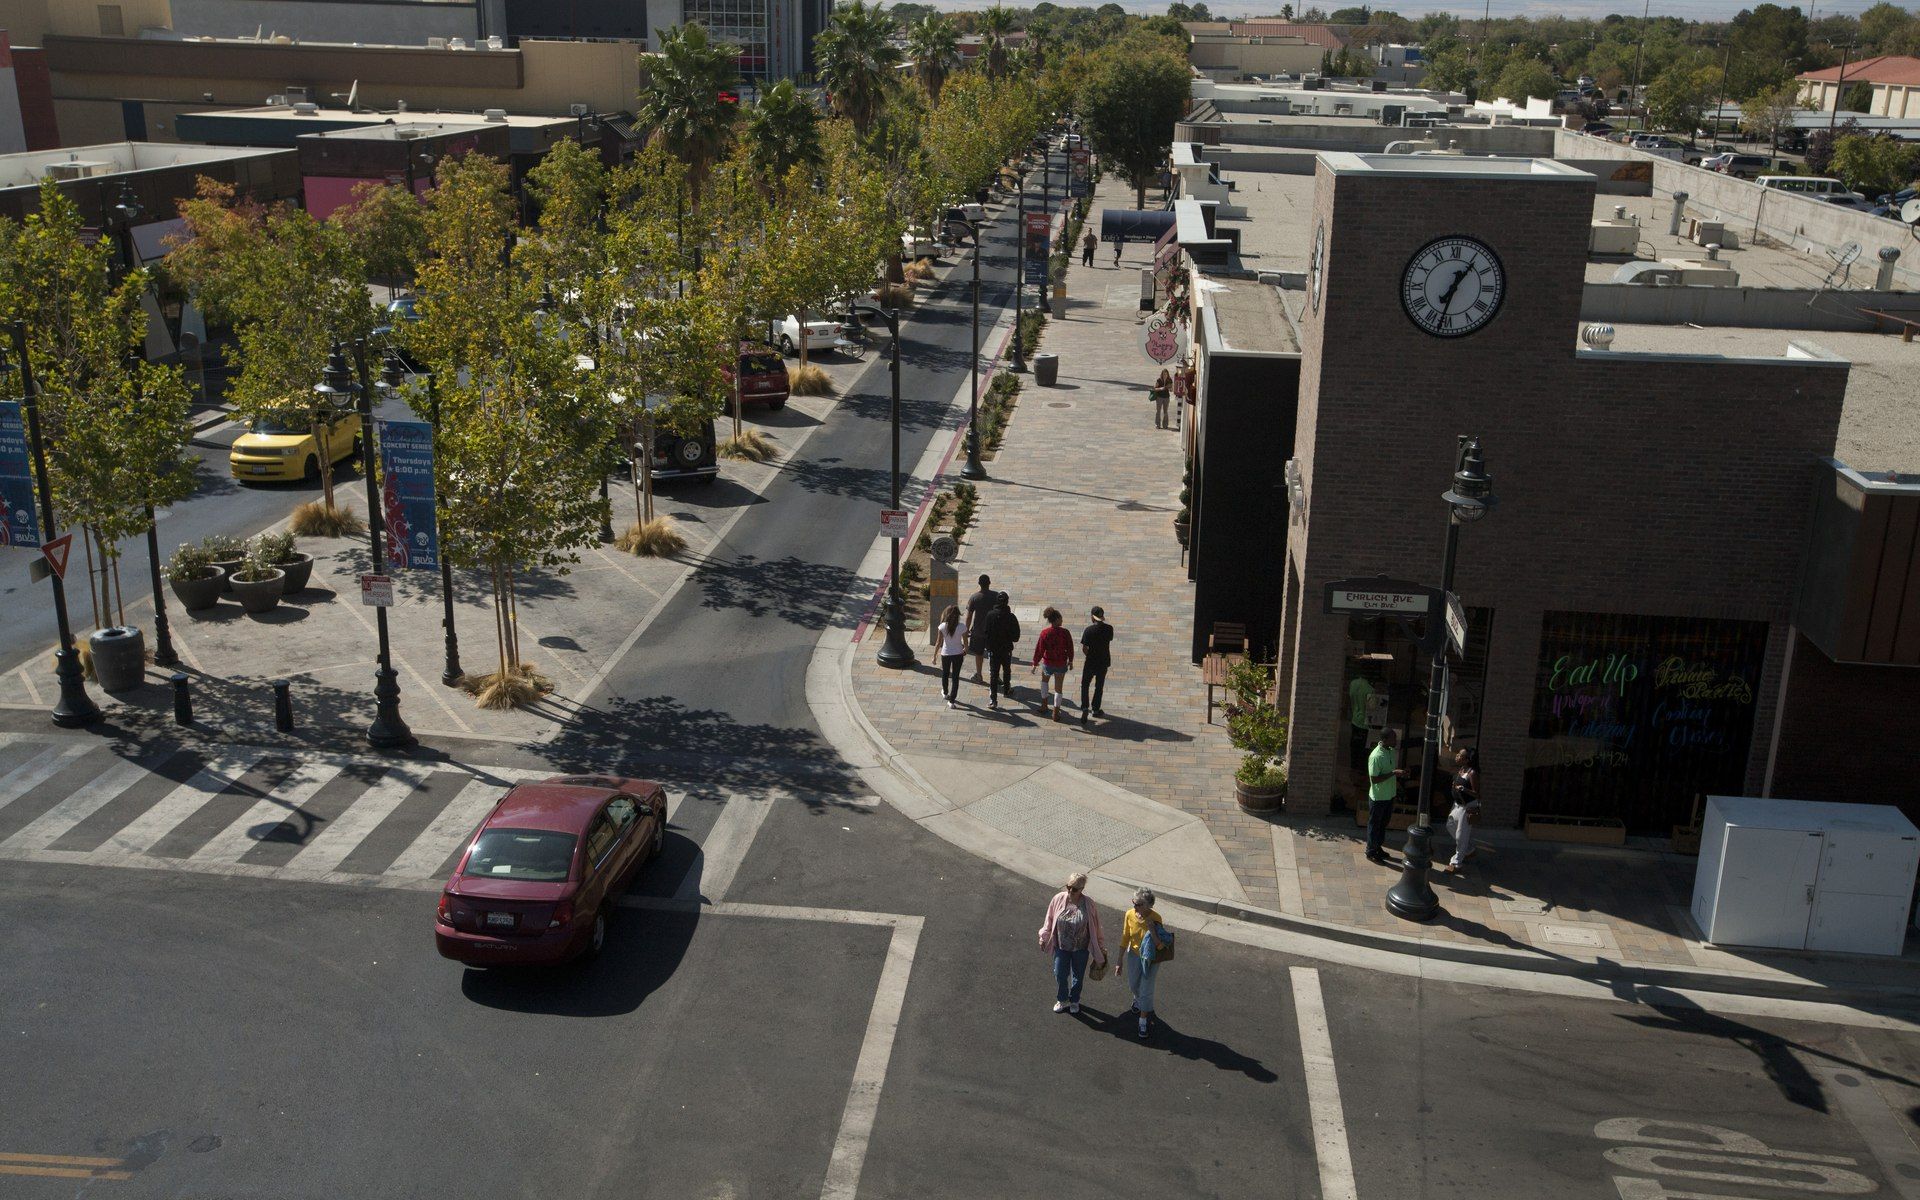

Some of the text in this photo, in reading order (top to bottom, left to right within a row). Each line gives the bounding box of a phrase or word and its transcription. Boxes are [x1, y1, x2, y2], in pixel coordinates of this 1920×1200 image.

[1450, 246, 1462, 259] XII
[1151, 340, 1173, 351] Happy
[392, 456, 432, 466] Thursdays
[1346, 592, 1388, 602] EHRLICH
[1549, 653, 1638, 697] Eat Up
[474, 942, 518, 951] SATURN
